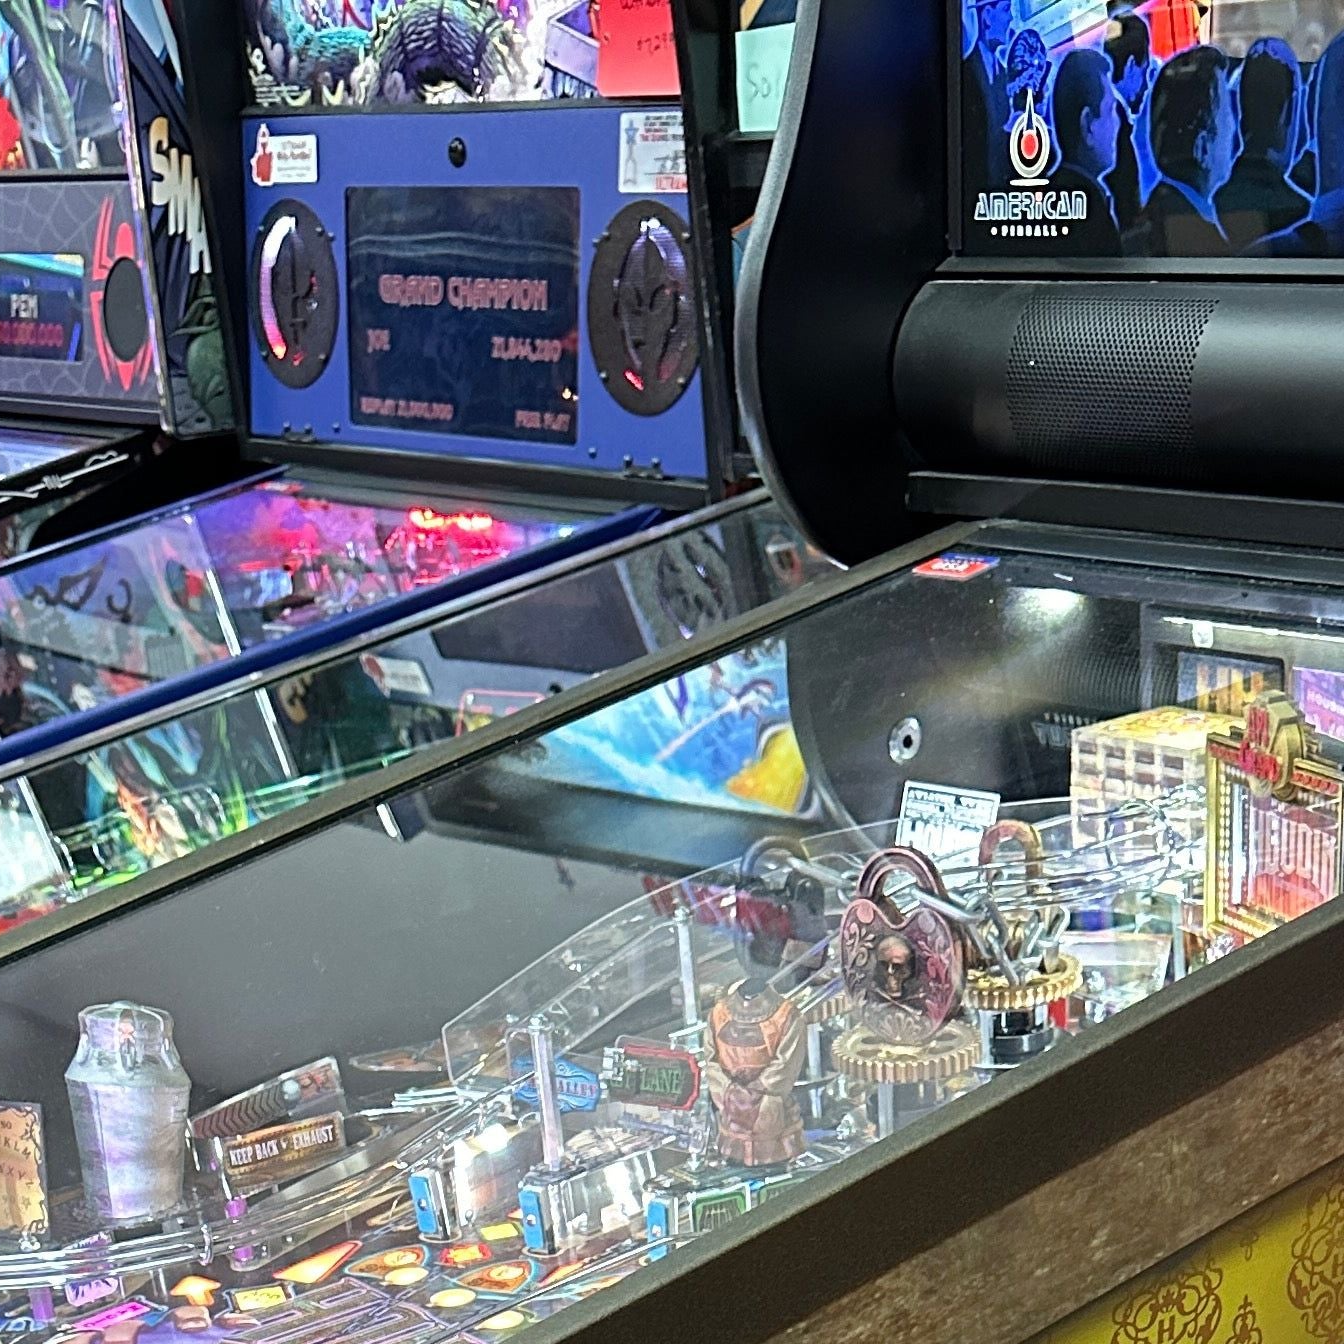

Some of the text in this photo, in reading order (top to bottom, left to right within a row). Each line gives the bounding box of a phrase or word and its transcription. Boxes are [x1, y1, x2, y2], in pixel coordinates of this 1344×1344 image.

[974, 191, 1087, 220] AMERICAN
[378, 273, 548, 312] GRAND CHAMPION
[639, 1066, 683, 1095] LANE
[0, 1119, 13, 1131] NO
[229, 1123, 335, 1167] KEEP BACK EXHAUST
